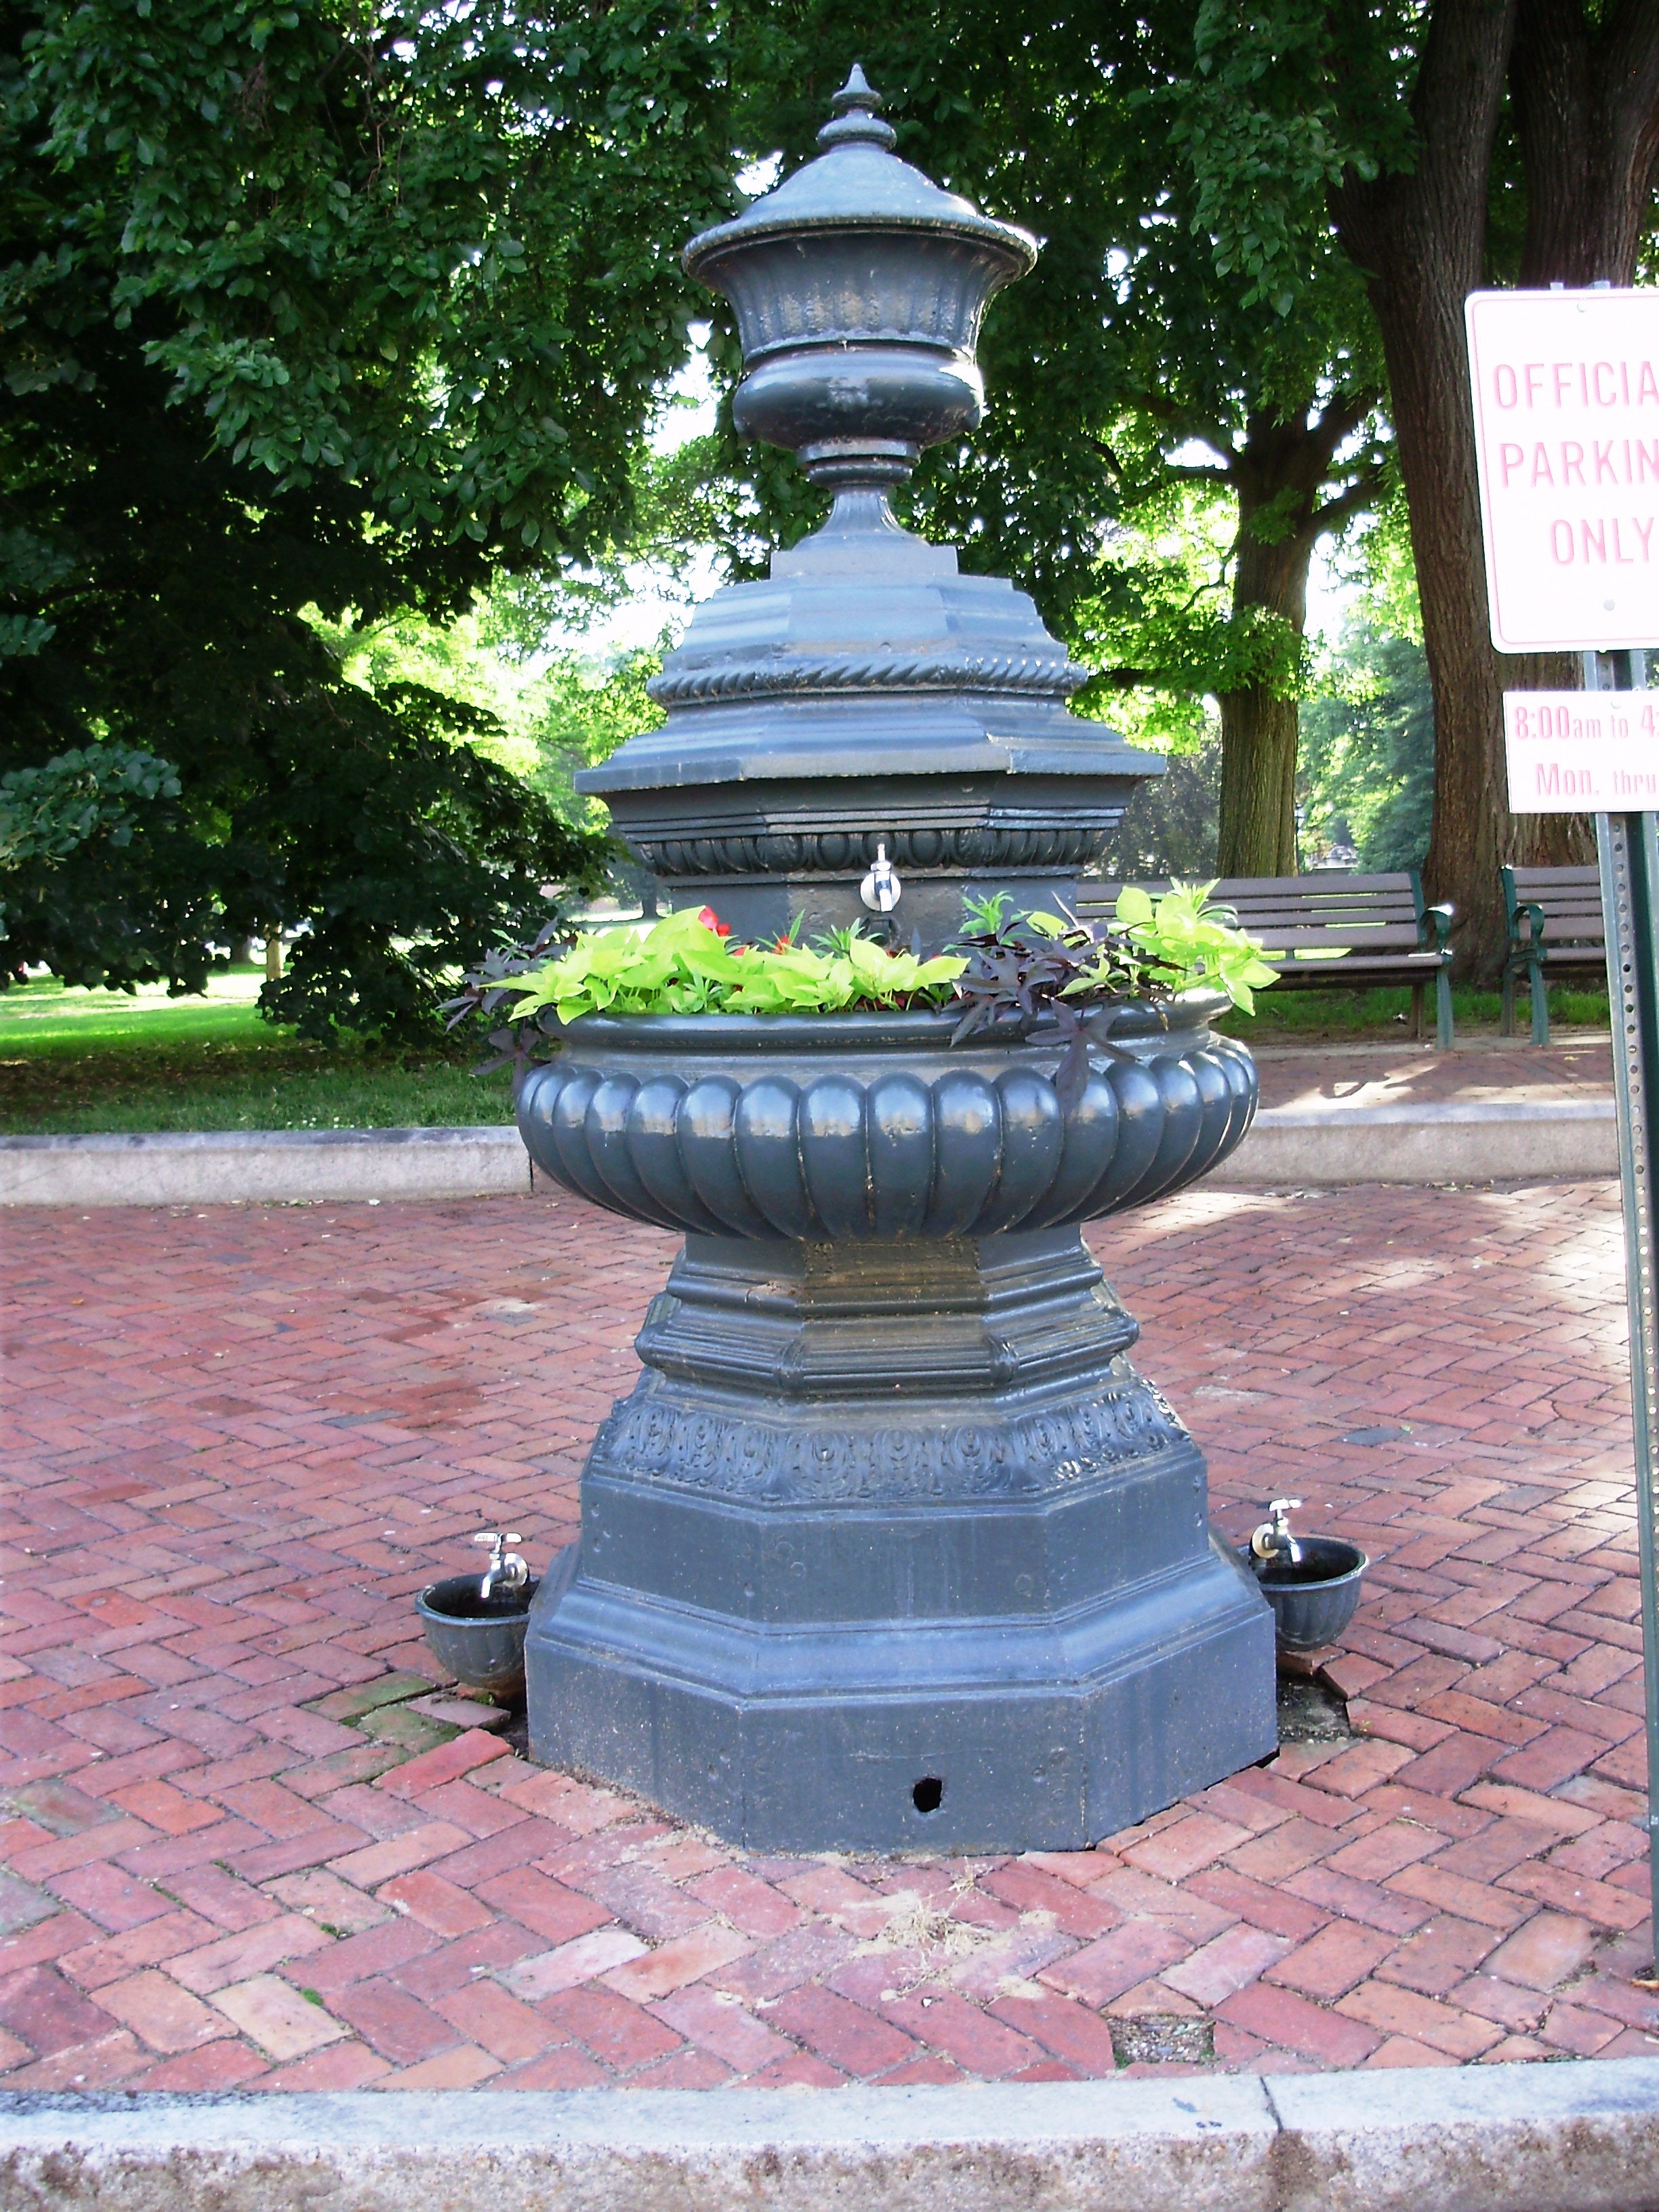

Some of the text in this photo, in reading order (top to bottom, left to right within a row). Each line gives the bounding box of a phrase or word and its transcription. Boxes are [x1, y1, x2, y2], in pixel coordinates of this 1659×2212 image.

[1550, 517, 1654, 565] ONLY
[1514, 706, 1601, 739] 8:00am
[1610, 714, 1629, 738] to
[1535, 763, 1656, 796] Mon. thru
